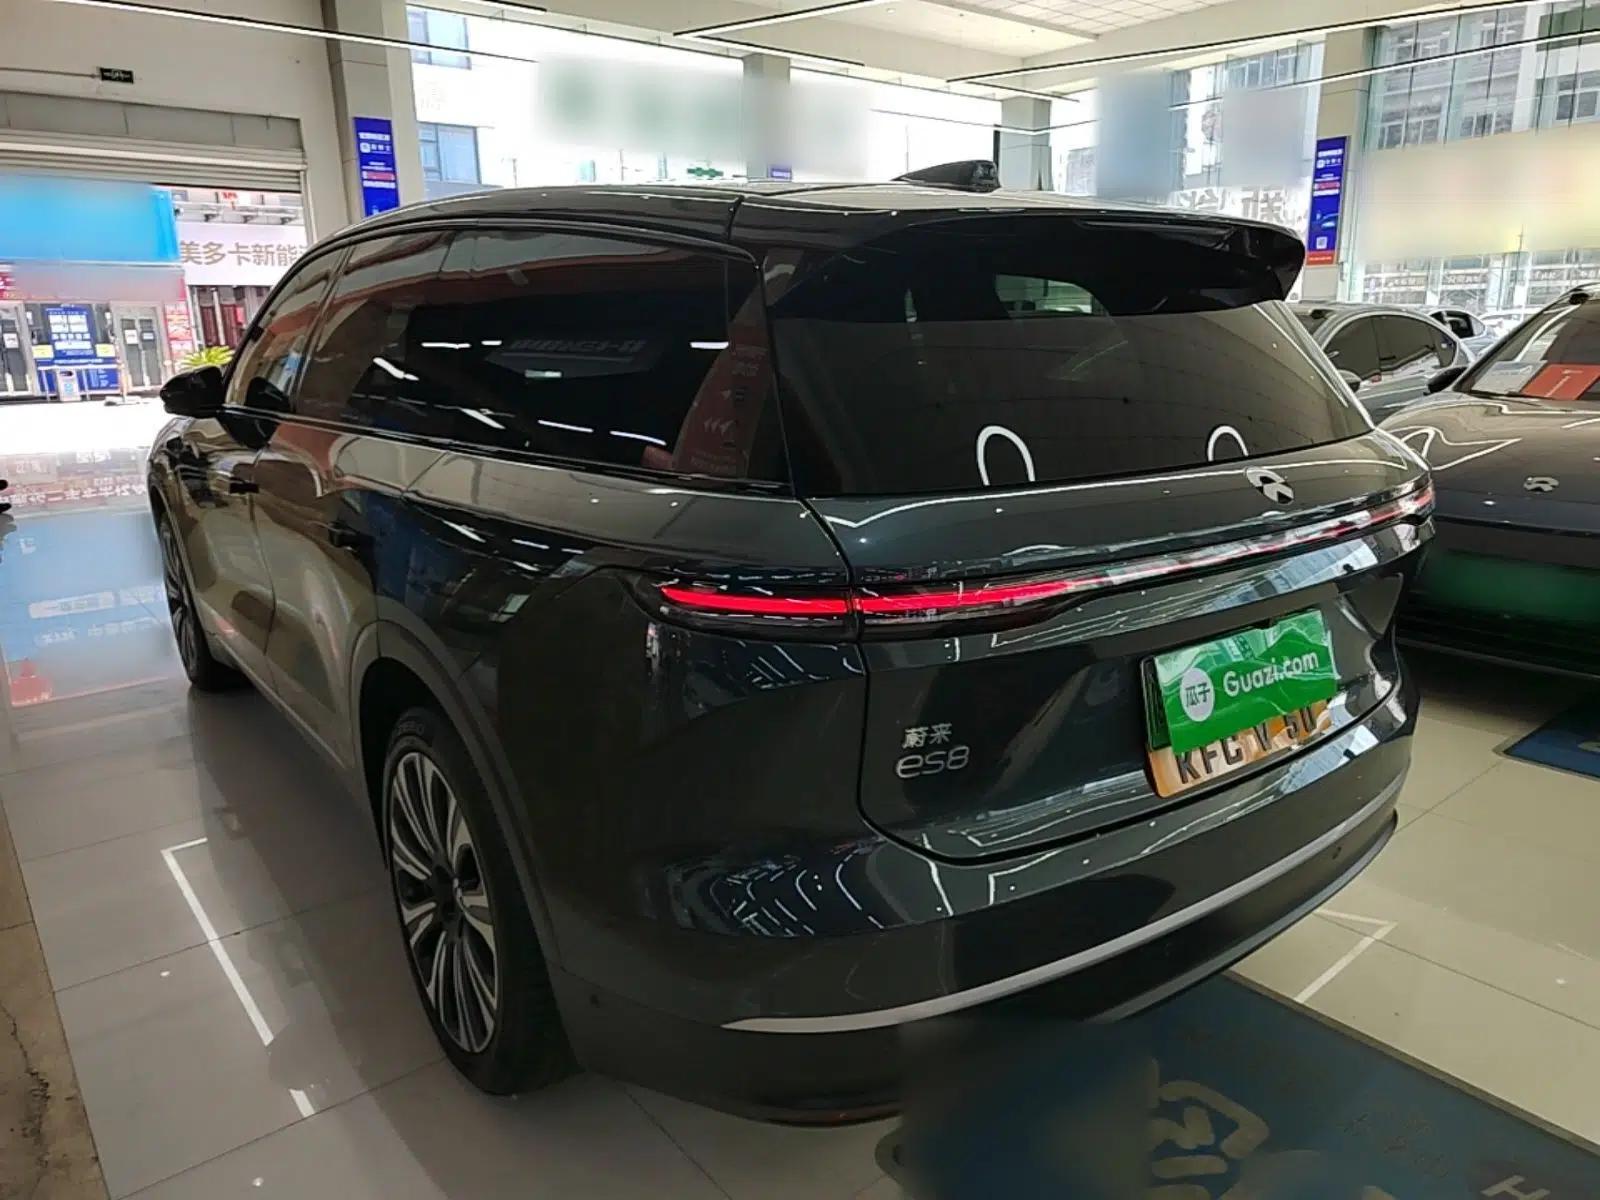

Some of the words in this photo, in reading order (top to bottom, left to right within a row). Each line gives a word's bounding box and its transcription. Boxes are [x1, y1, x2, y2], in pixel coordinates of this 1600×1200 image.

[1223, 651, 1319, 697] Guazi.com
[1184, 682, 1211, 708] 瓜子
[902, 722, 952, 749] 蔚来
